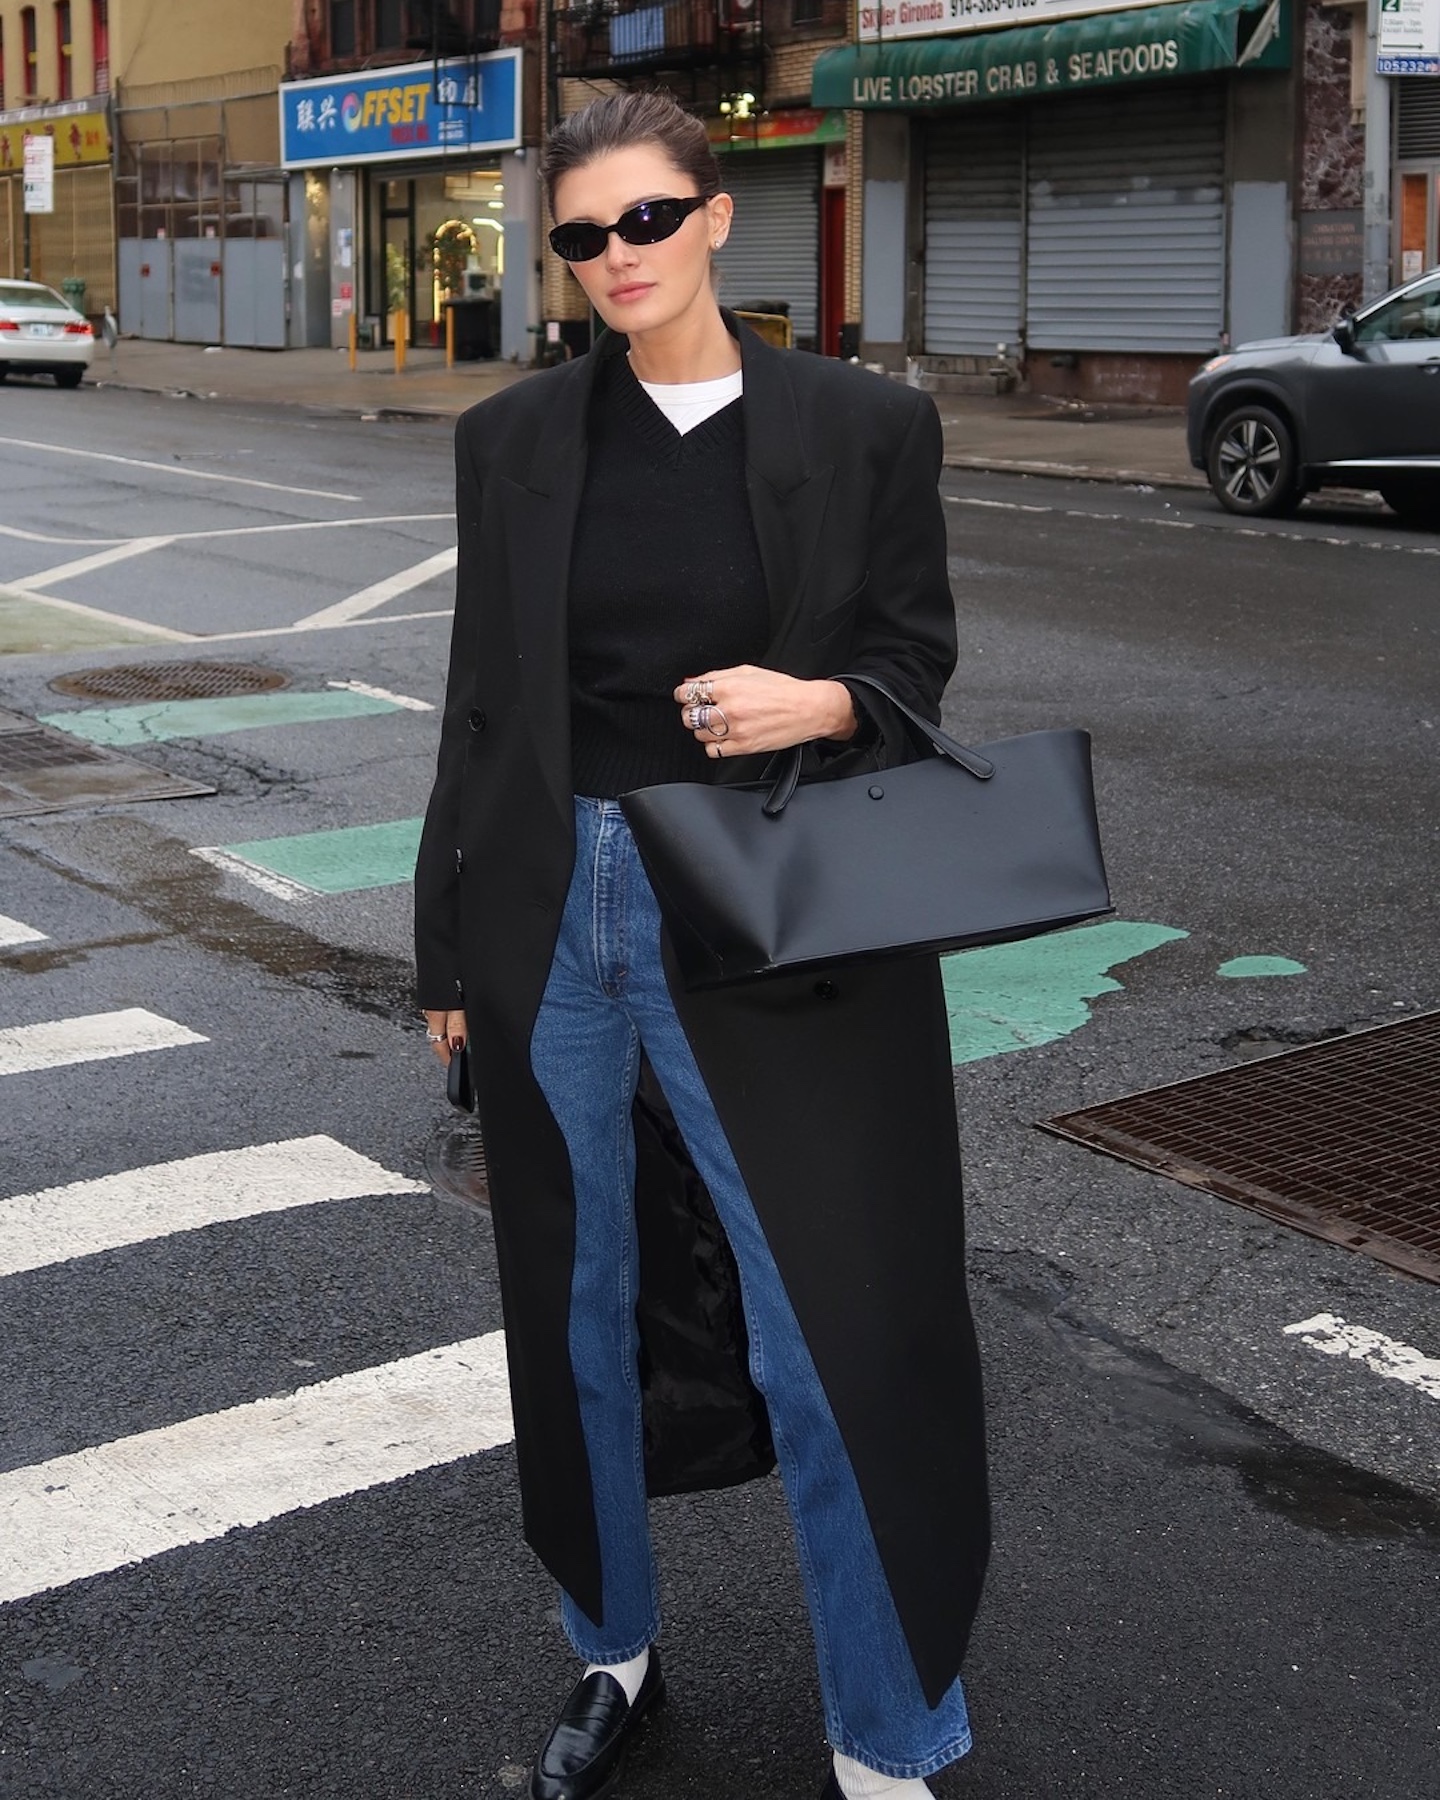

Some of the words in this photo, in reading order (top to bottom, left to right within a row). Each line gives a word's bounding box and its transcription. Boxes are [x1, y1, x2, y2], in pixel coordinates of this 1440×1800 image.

[862, 8, 896, 28] Skler
[900, 0, 944, 24] Gironda
[853, 76, 892, 102] LIVE
[899, 69, 978, 100] LOBSTER
[986, 61, 1037, 93] CRAB
[1045, 58, 1060, 85] &
[1068, 40, 1178, 82] SEAFOODS
[1379, 60, 1425, 72] 105232
